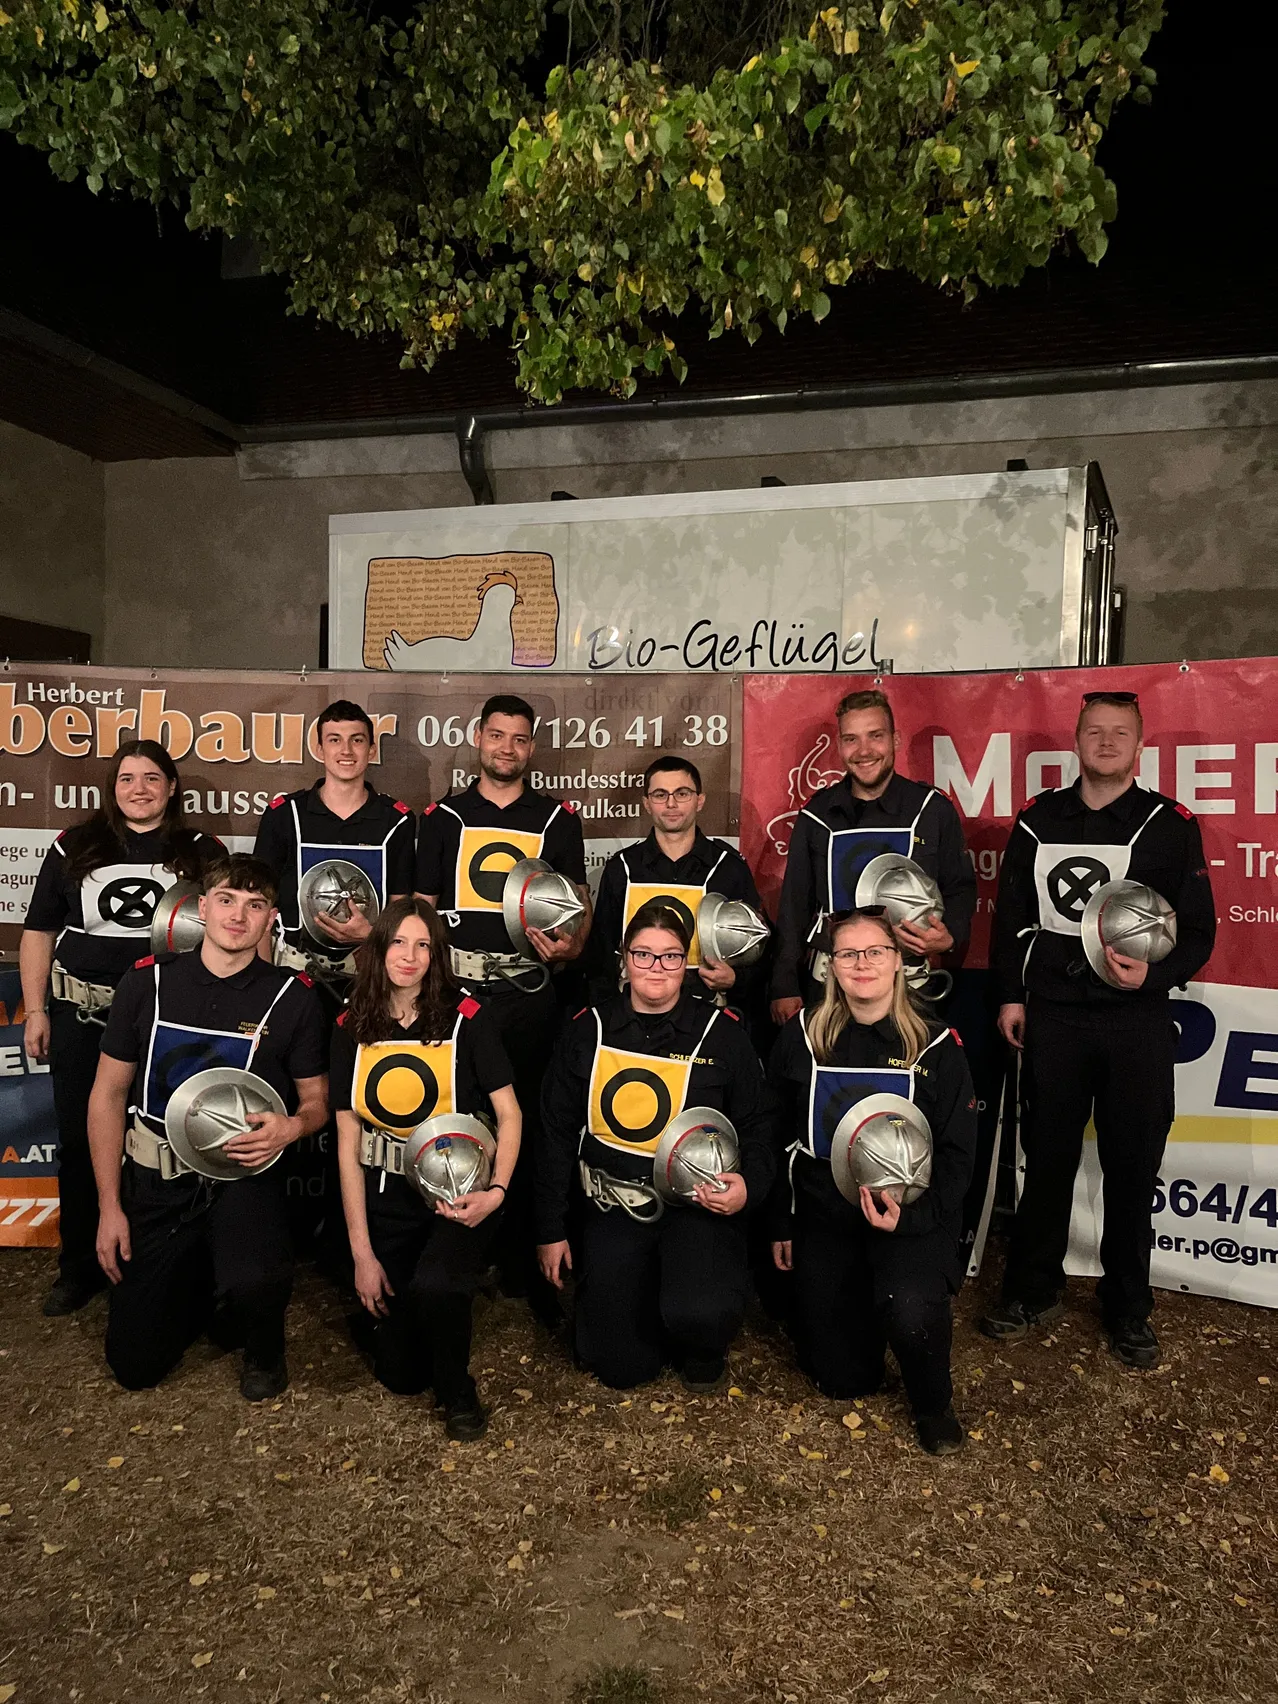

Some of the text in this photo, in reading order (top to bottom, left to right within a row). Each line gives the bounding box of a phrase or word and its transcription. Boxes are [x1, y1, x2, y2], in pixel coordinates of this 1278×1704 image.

[588, 618, 881, 672] Bio-Geflügel
[27, 682, 125, 706] Herbert
[624, 715, 663, 747] 41
[683, 714, 728, 747] 38
[569, 798, 640, 819] Pulkau
[1237, 842, 1278, 878] Tr
[1229, 905, 1278, 923] Schl
